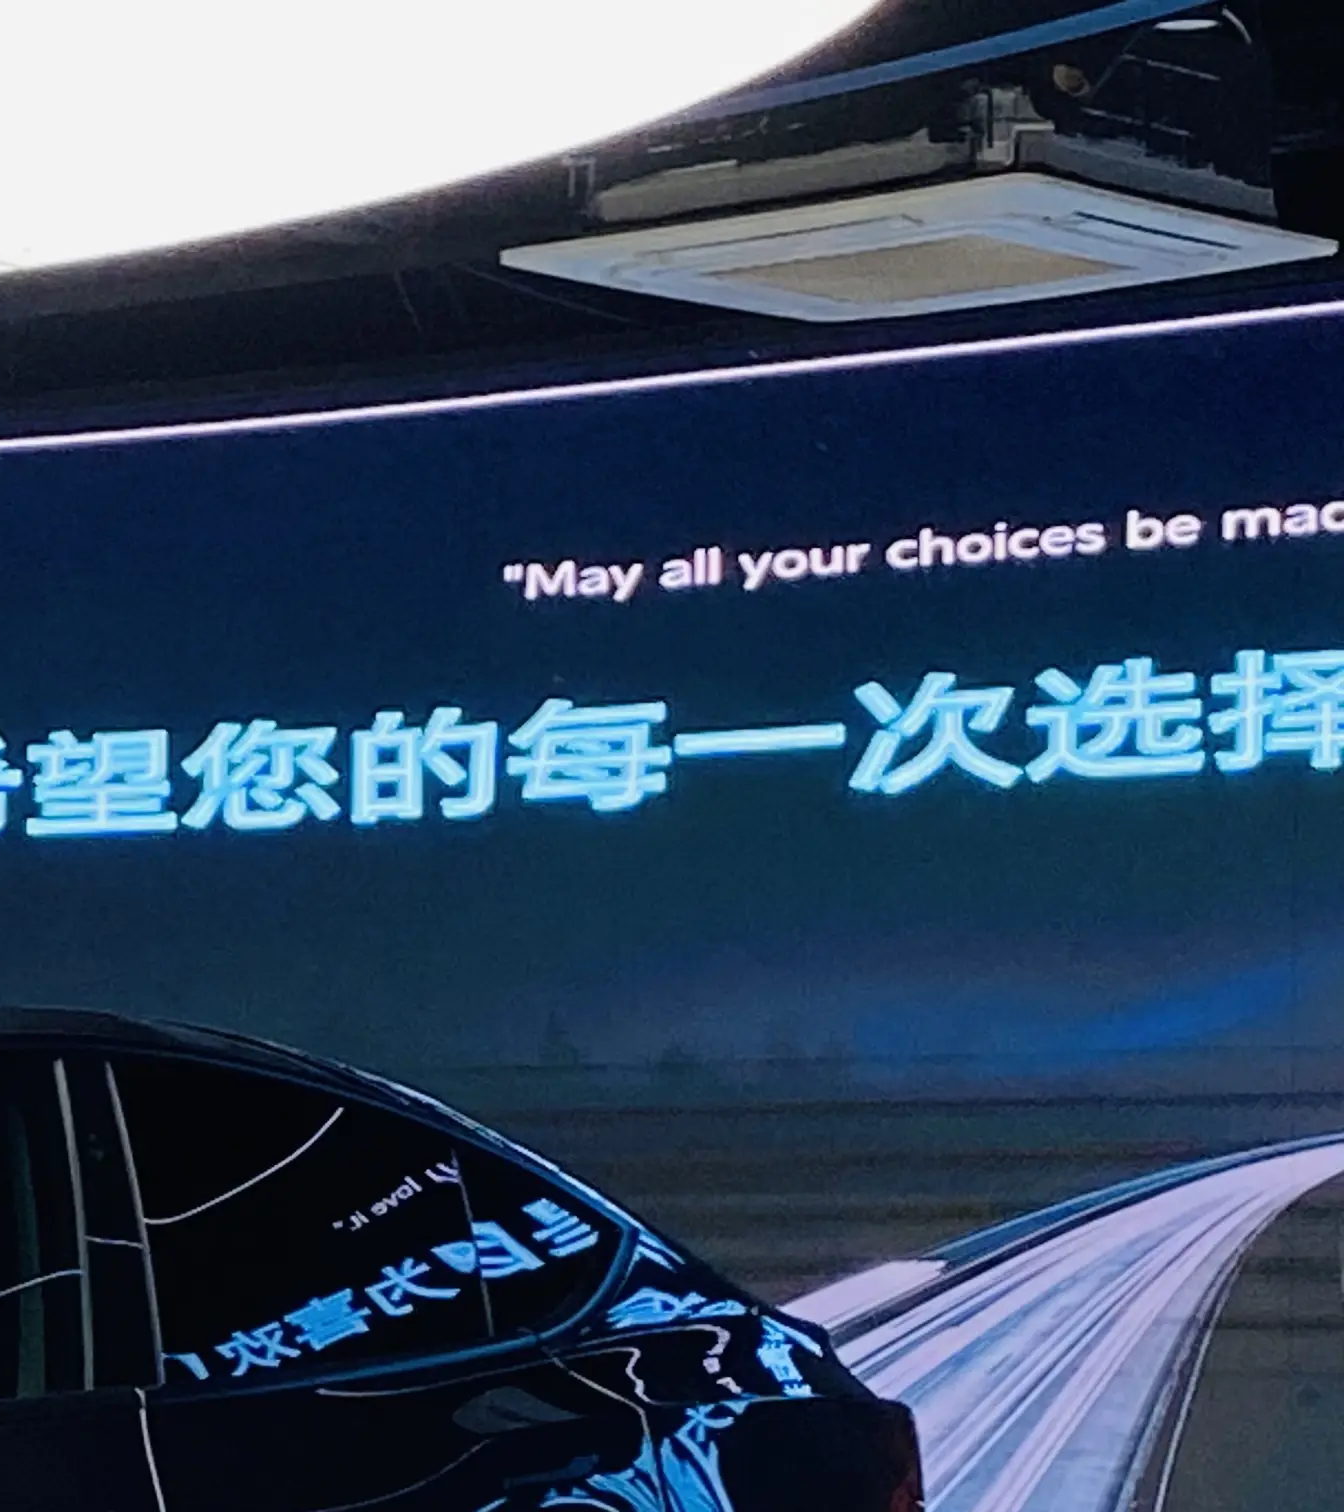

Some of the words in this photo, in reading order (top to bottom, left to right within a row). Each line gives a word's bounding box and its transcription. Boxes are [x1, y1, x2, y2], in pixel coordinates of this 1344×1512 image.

[503, 559, 644, 602] "May
[658, 546, 723, 589] all
[737, 543, 871, 591] your
[885, 521, 1107, 570] choices
[1125, 509, 1202, 550] be
